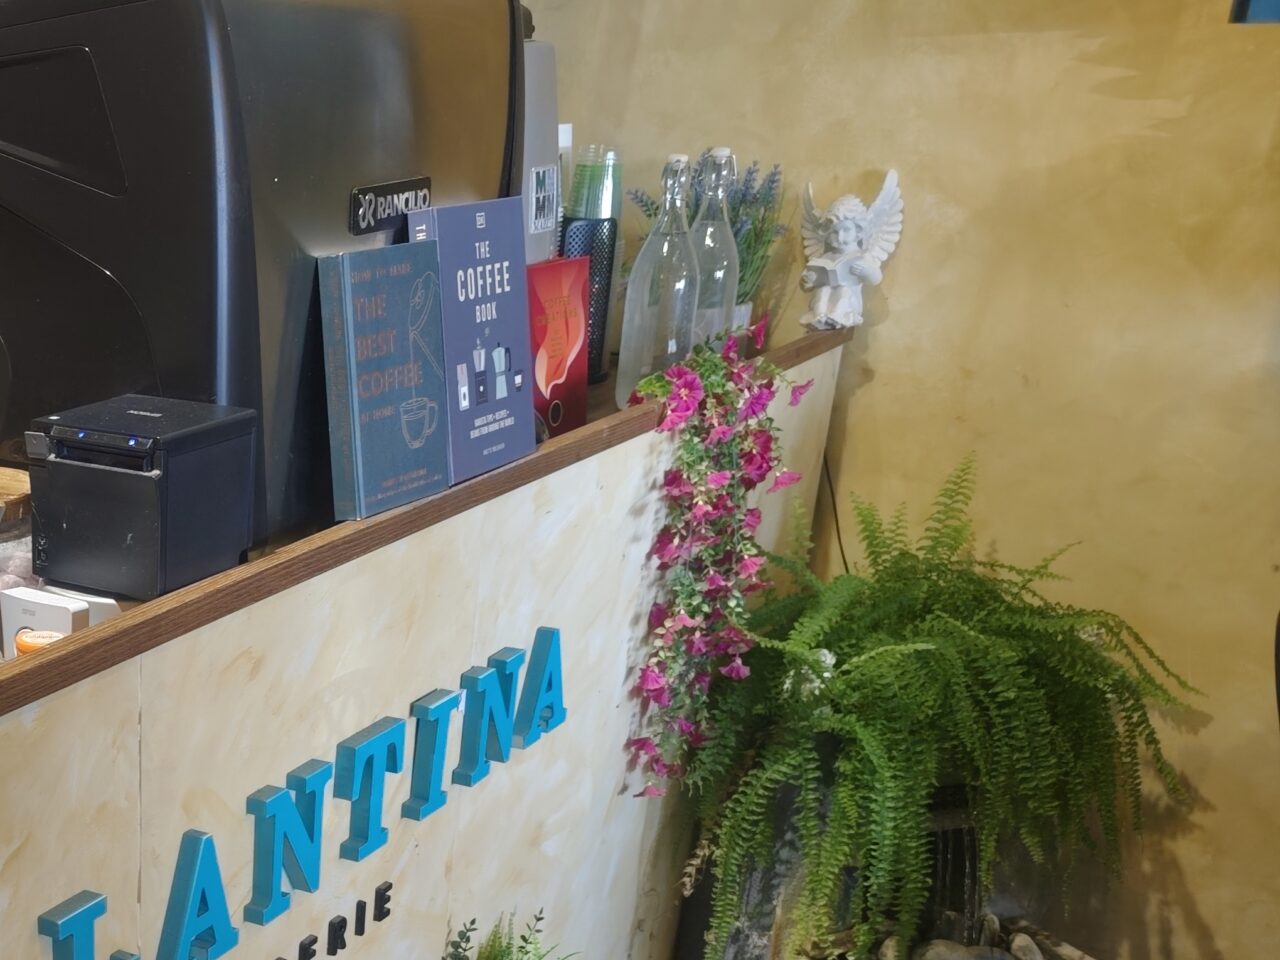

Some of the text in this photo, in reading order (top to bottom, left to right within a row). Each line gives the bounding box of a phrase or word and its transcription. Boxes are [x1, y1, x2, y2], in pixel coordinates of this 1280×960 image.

[377, 188, 430, 220] RANCILIO
[415, 224, 426, 240] TH
[475, 241, 490, 259] THE
[457, 261, 511, 302] COFFEE
[355, 294, 386, 320] THE
[475, 302, 497, 323] BOOK
[357, 331, 396, 361] BEST
[358, 362, 424, 398] COFFEE
